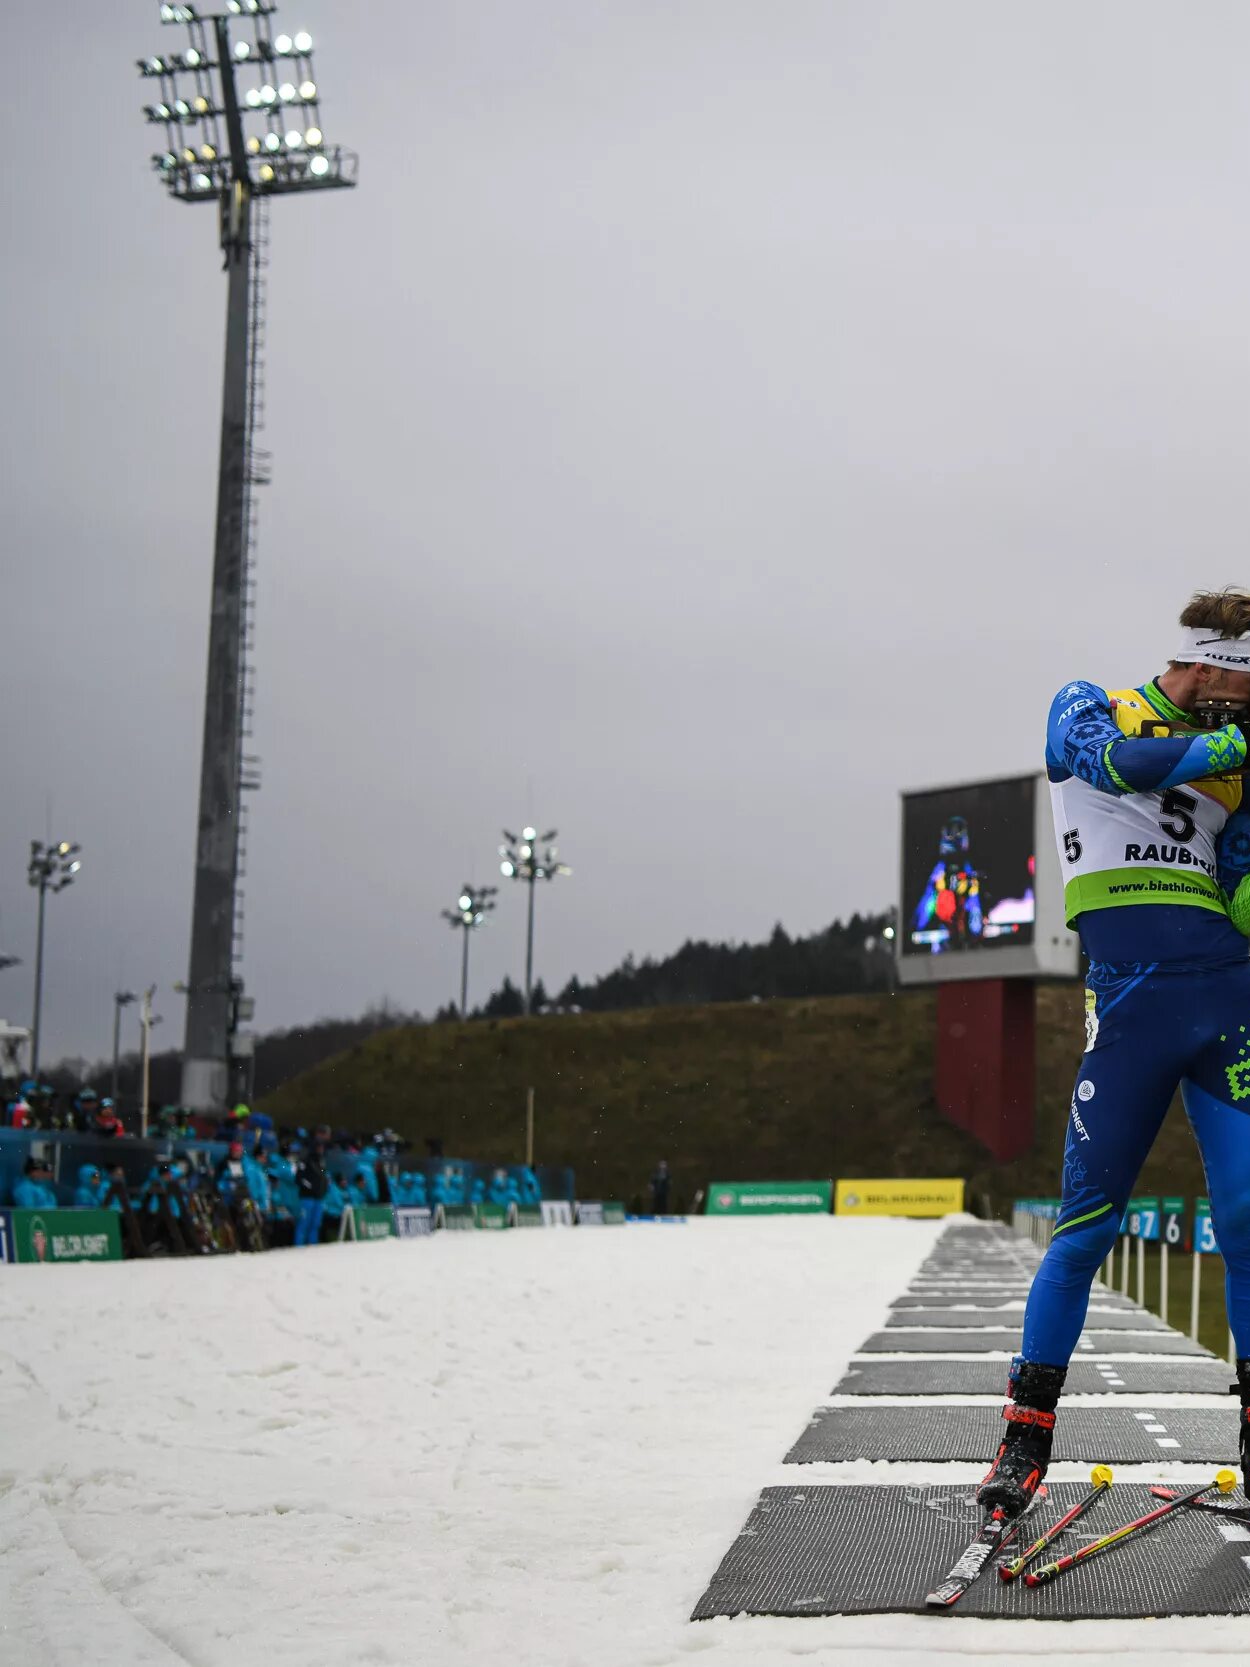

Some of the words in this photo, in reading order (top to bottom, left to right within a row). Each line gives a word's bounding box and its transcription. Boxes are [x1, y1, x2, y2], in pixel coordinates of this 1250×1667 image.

[1058, 699, 1095, 725] ATEX
[1159, 787, 1198, 844] 5
[1063, 828, 1083, 864] 5
[1141, 1211, 1155, 1238] 7
[1166, 1213, 1180, 1243] 6
[1200, 1217, 1217, 1250] 5
